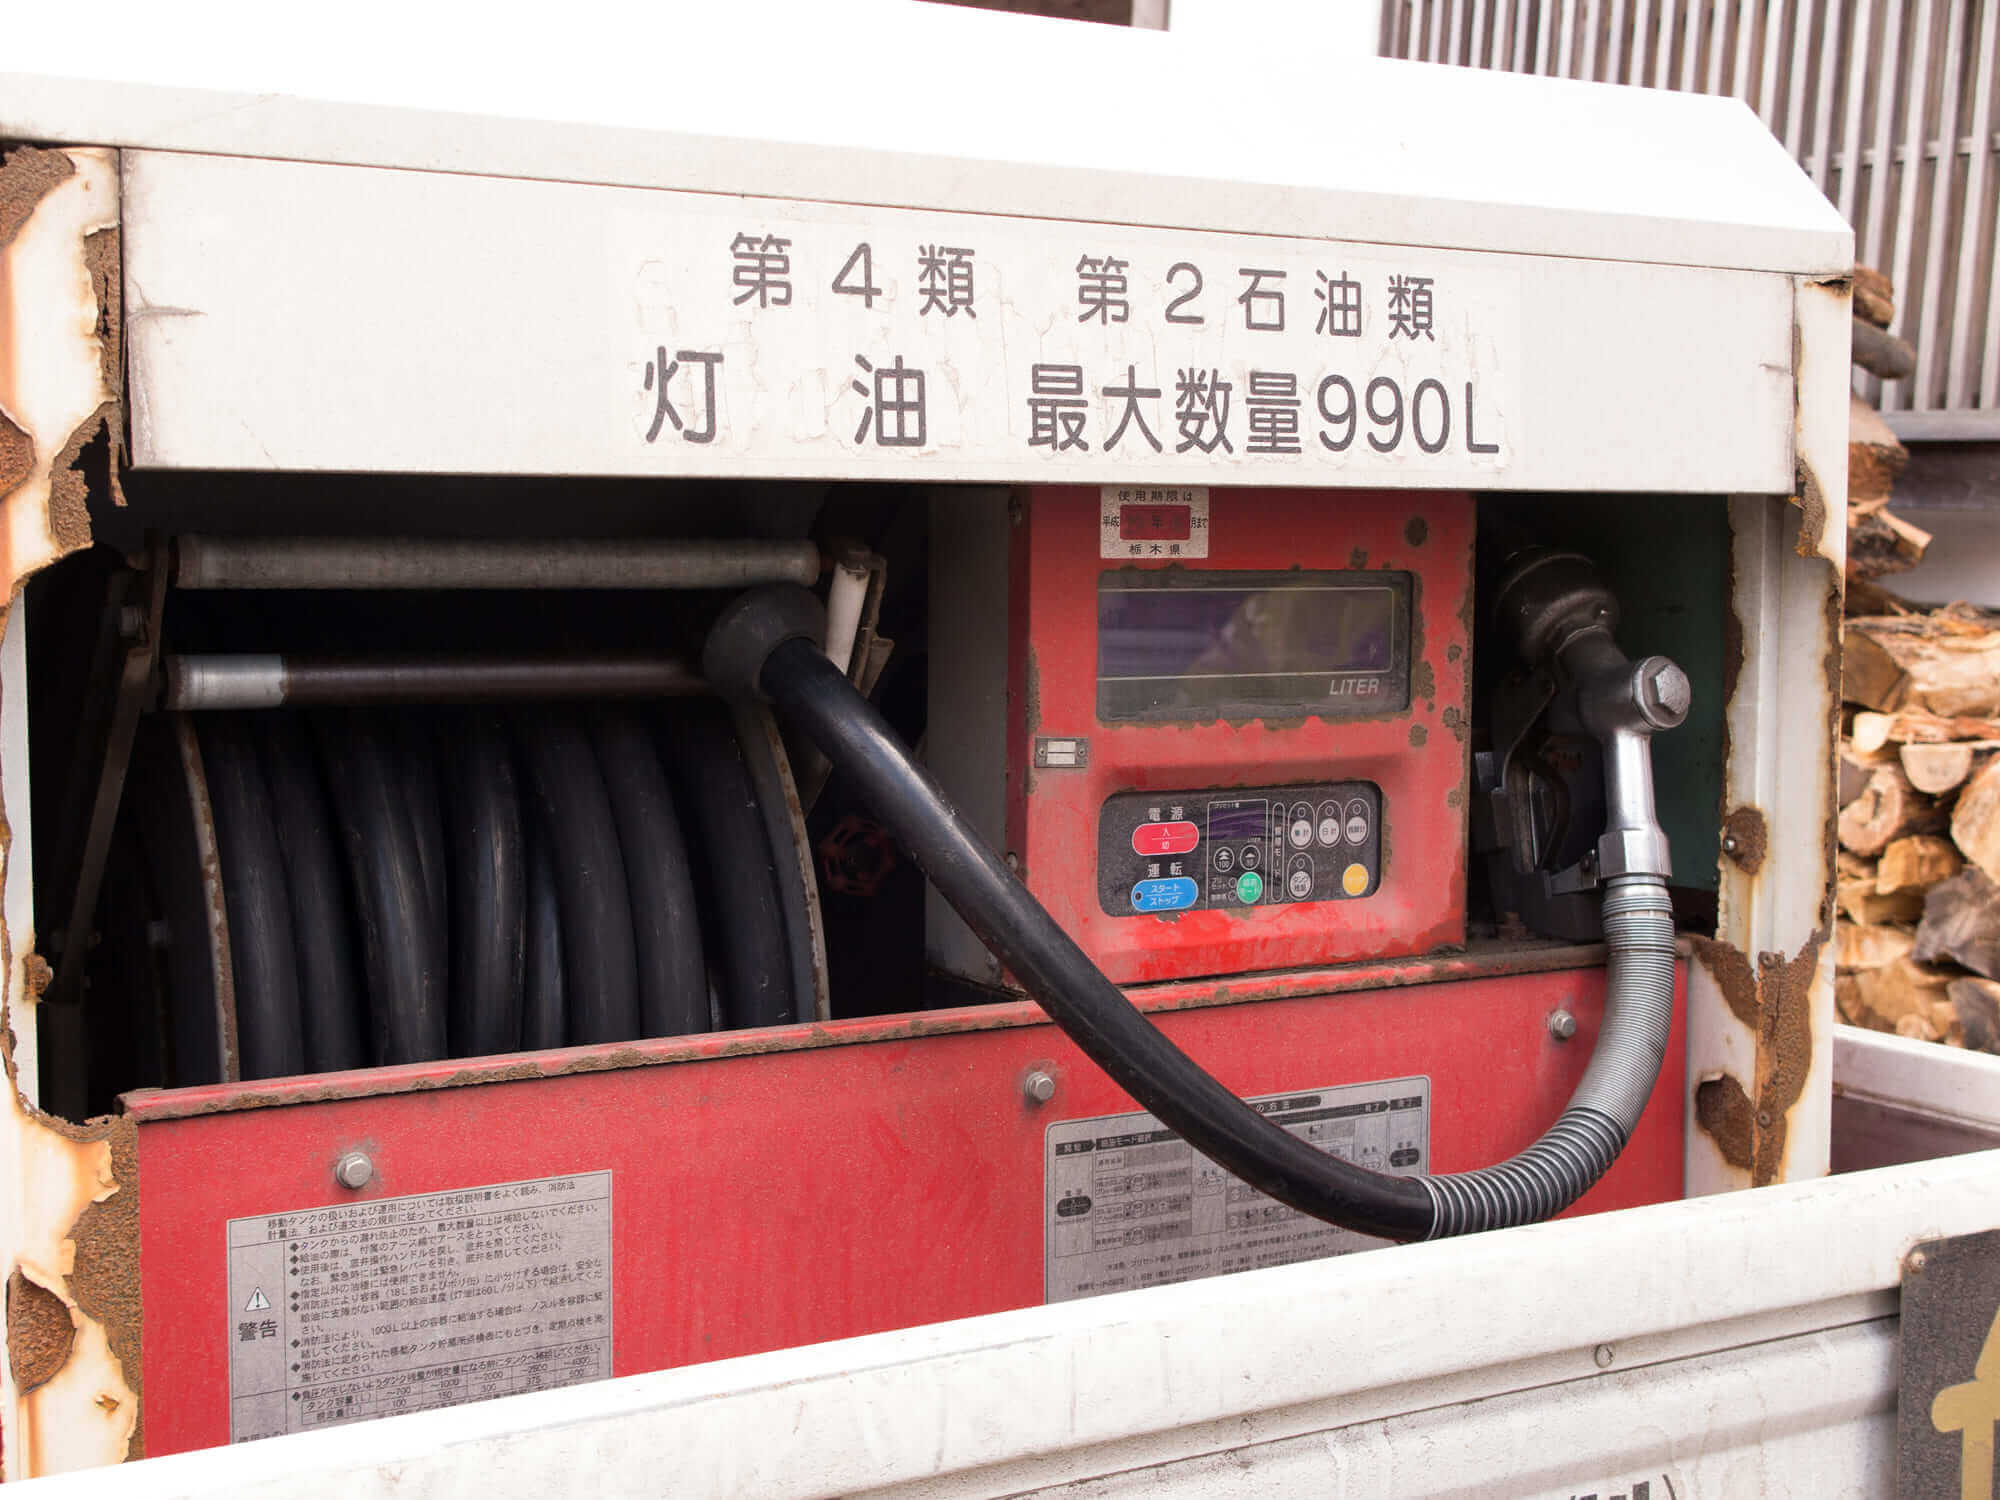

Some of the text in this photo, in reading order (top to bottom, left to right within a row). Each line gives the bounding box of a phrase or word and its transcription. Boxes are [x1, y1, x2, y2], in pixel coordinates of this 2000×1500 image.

[1028, 363, 1500, 456] 最大数量990L
[1118, 490, 1193, 502] 使用期限は
[1128, 543, 1182, 555] 栃木県
[1329, 678, 1380, 696] LITER
[1148, 806, 1185, 822] 電源
[1147, 862, 1184, 878] 運転
[1150, 883, 1182, 894] スタート
[1149, 895, 1181, 907] ストップ
[238, 1317, 278, 1342] 警告
